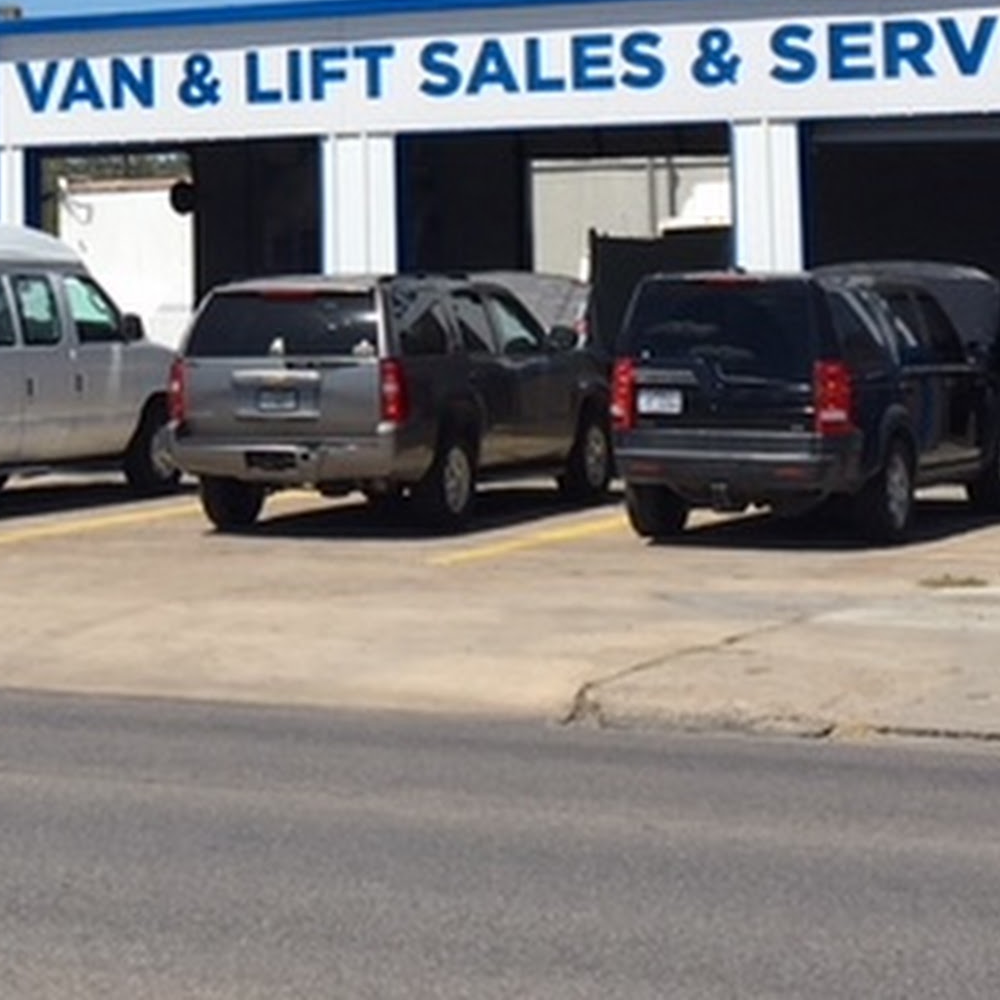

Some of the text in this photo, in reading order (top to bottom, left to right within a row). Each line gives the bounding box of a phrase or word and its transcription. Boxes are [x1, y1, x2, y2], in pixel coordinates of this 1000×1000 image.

[17, 16, 997, 112] VAN & LIFT SALES & SERV
